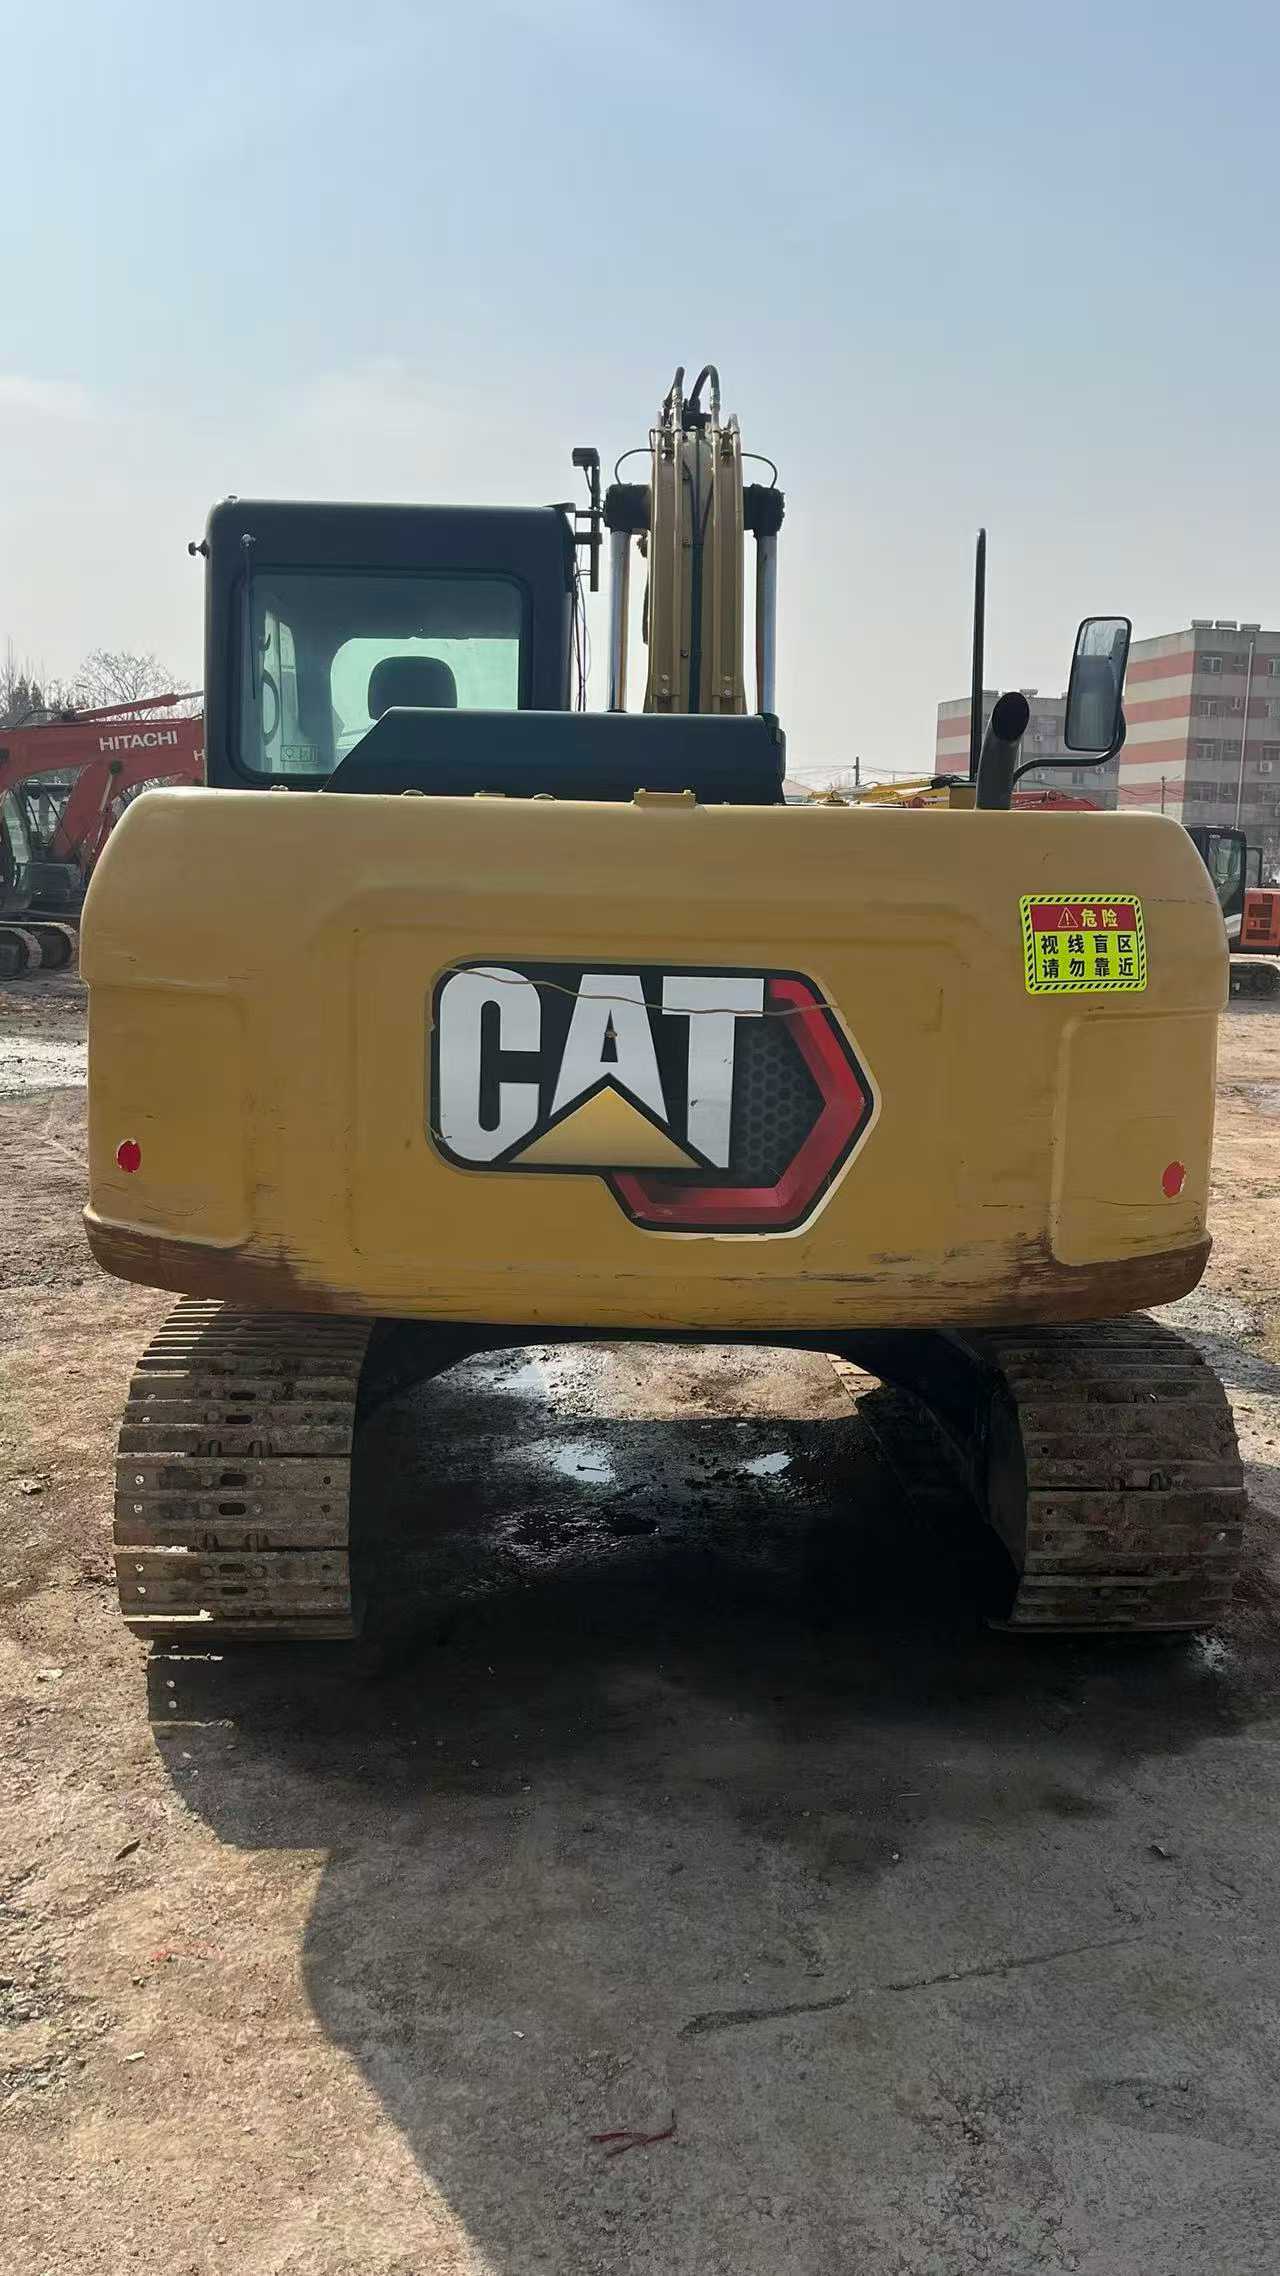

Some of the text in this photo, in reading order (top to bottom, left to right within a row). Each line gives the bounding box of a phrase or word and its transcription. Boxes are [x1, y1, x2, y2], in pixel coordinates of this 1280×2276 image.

[100, 731, 178, 751] HITACHI
[1080, 908, 1119, 928] 危险
[1041, 934, 1133, 955] 视线盲区
[1042, 957, 1134, 978] 请勿靠近
[439, 967, 765, 1168] CAT
